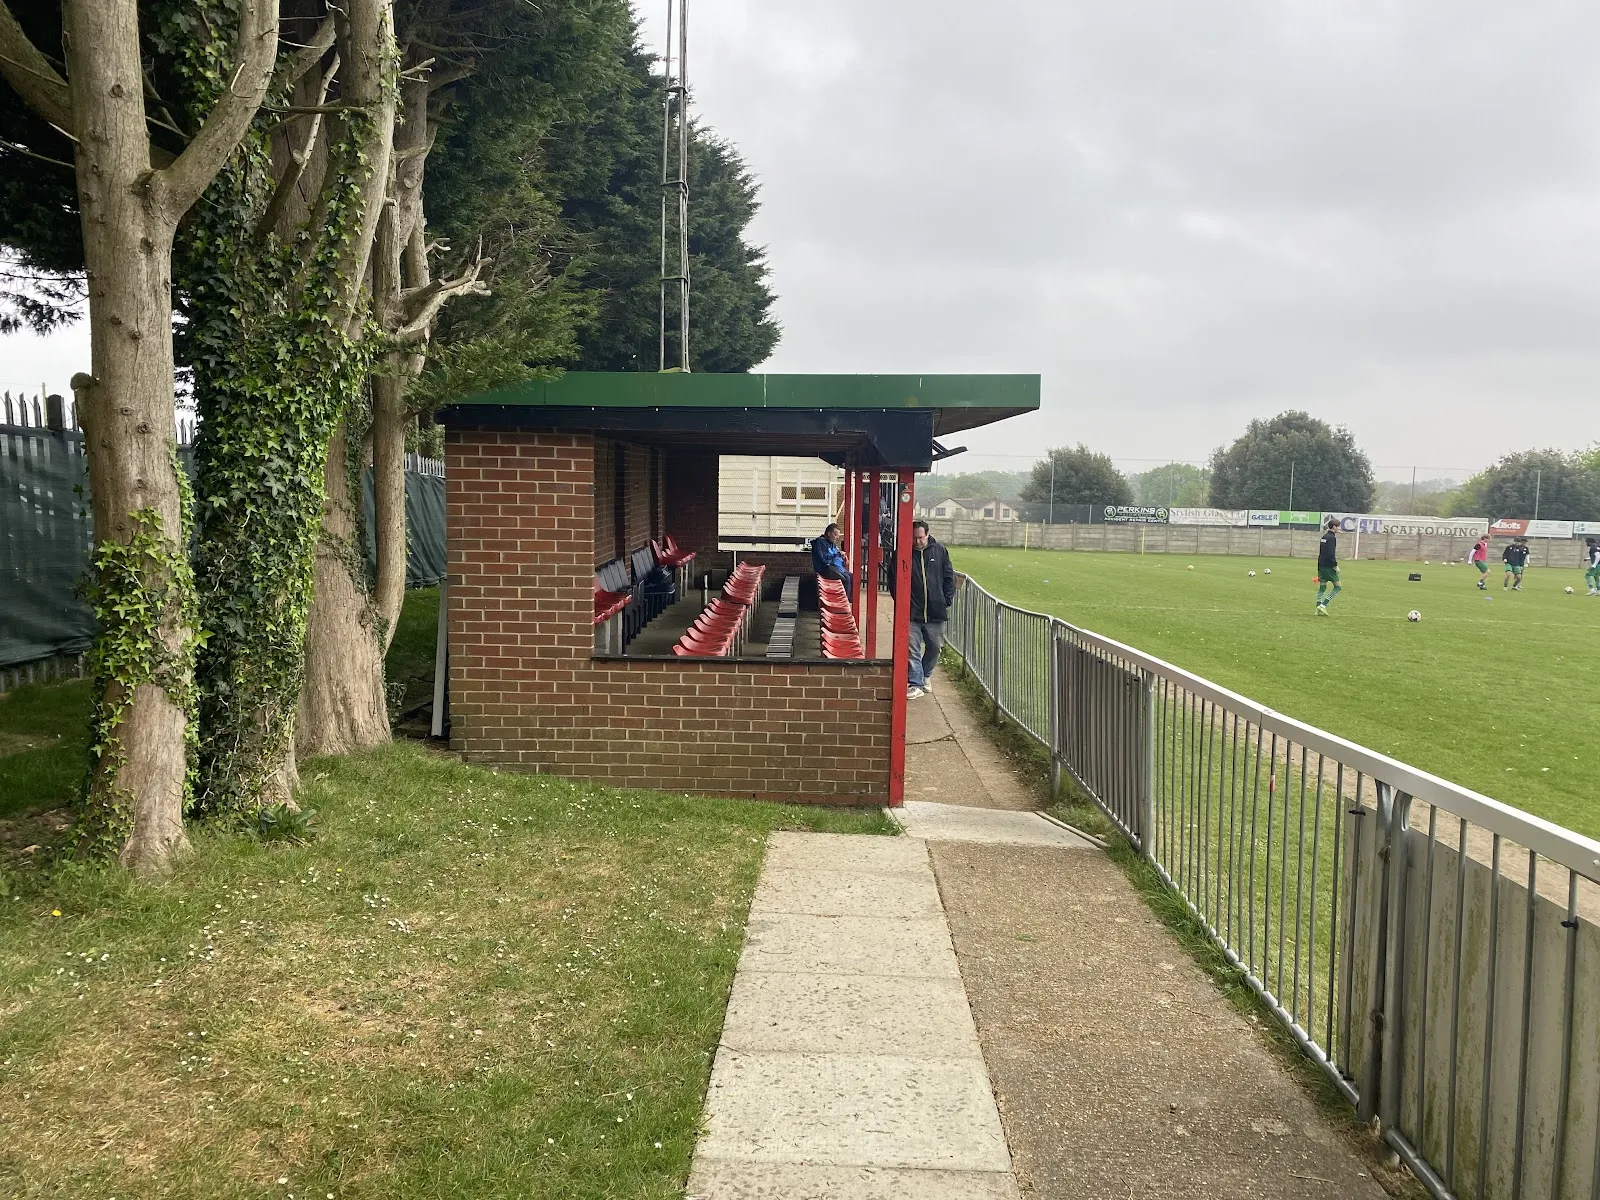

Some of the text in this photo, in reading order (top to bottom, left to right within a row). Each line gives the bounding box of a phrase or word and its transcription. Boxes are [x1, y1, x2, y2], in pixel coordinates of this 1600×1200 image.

[1117, 506, 1156, 514] PERKINS
[1170, 508, 1200, 518] Stylish
[1203, 509, 1228, 518] Glass
[1231, 510, 1246, 519] Ltd
[1383, 524, 1479, 537] SCAFFOLDING
